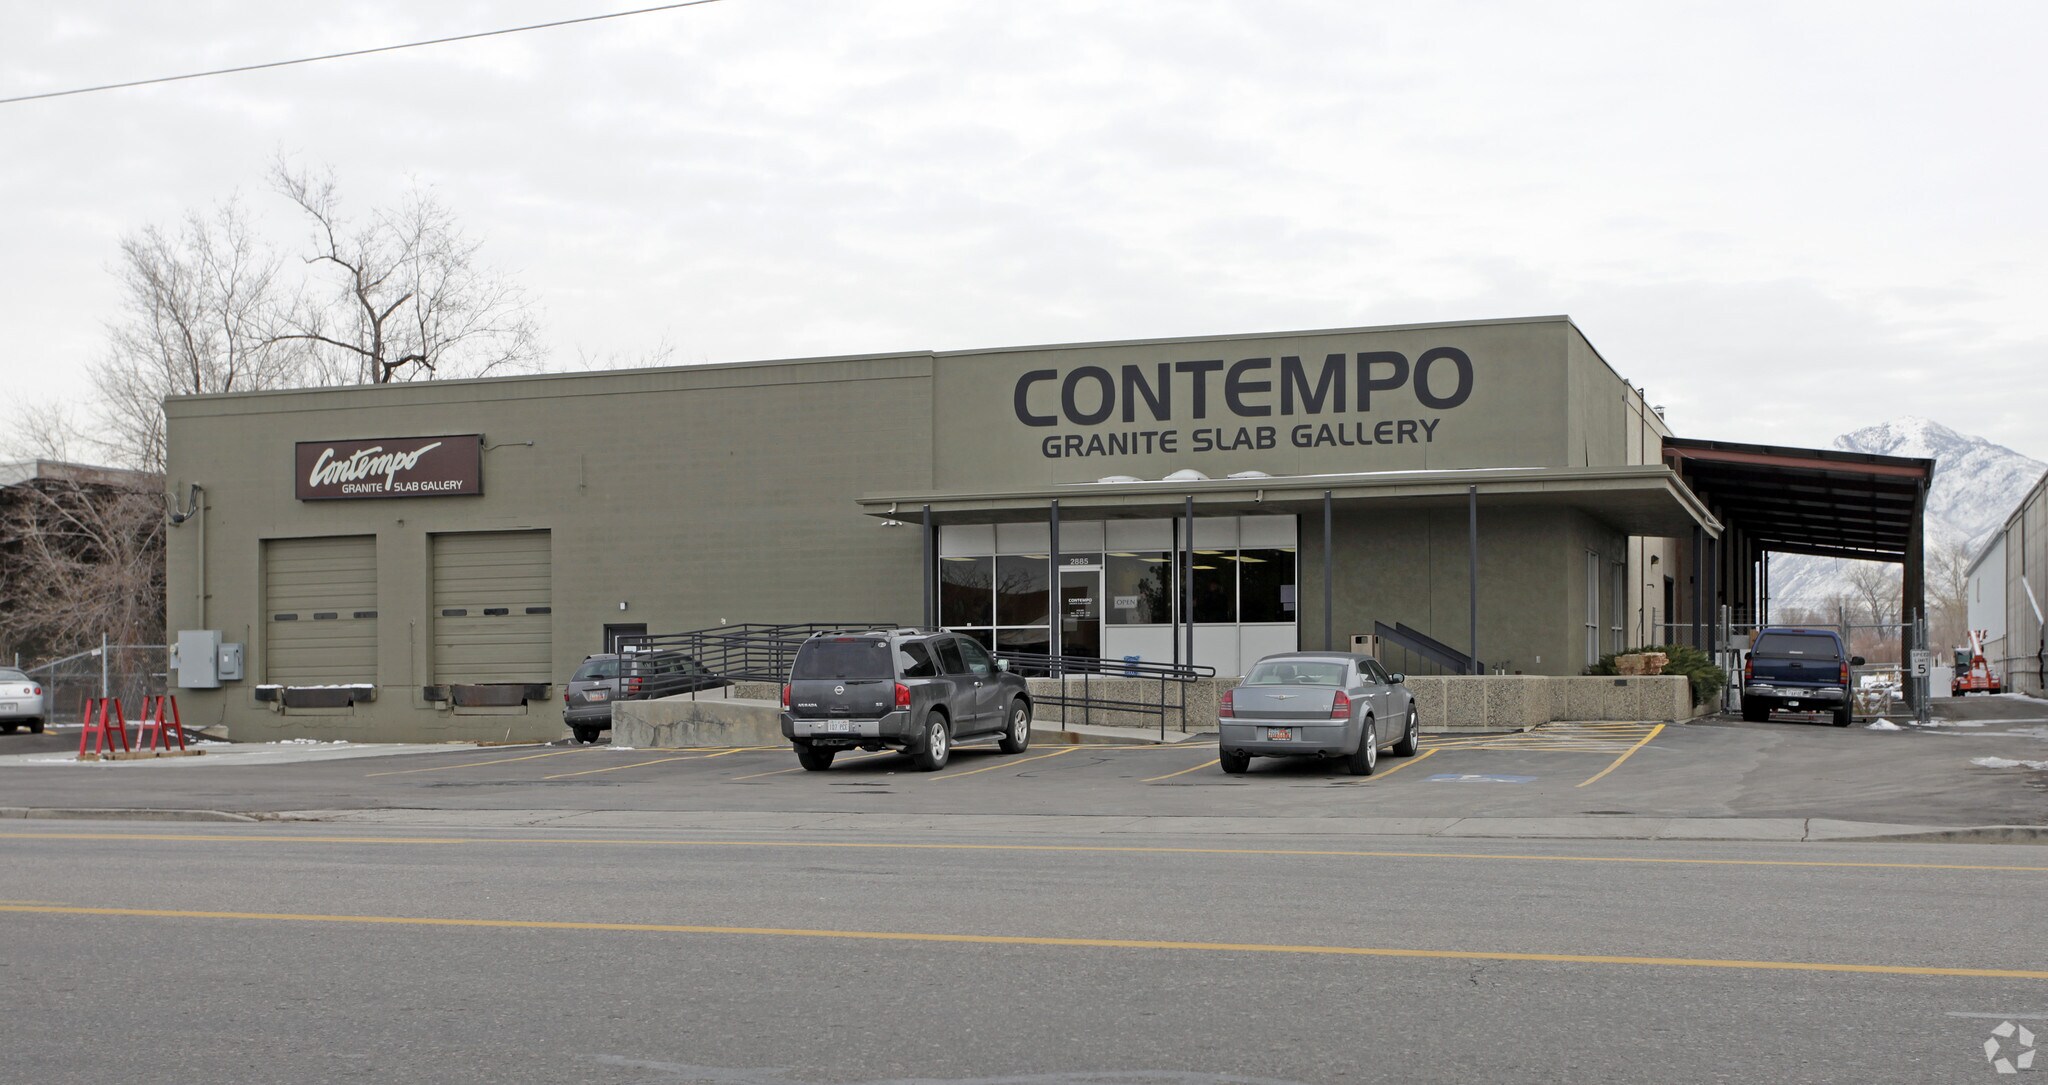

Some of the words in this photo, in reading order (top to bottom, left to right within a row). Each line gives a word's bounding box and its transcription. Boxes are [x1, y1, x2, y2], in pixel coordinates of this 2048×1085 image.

[1013, 346, 1474, 428] CONTEMPO
[1041, 429, 1178, 459] GRANITE
[1192, 426, 1277, 453] SLAB
[1291, 418, 1441, 448] GALLERY
[309, 441, 442, 491] Contempo
[342, 482, 383, 494] GRANITE
[394, 481, 419, 492] SLAB
[420, 479, 463, 491] GALLERY
[1070, 557, 1089, 565] 2885
[1917, 664, 1926, 674] 5
